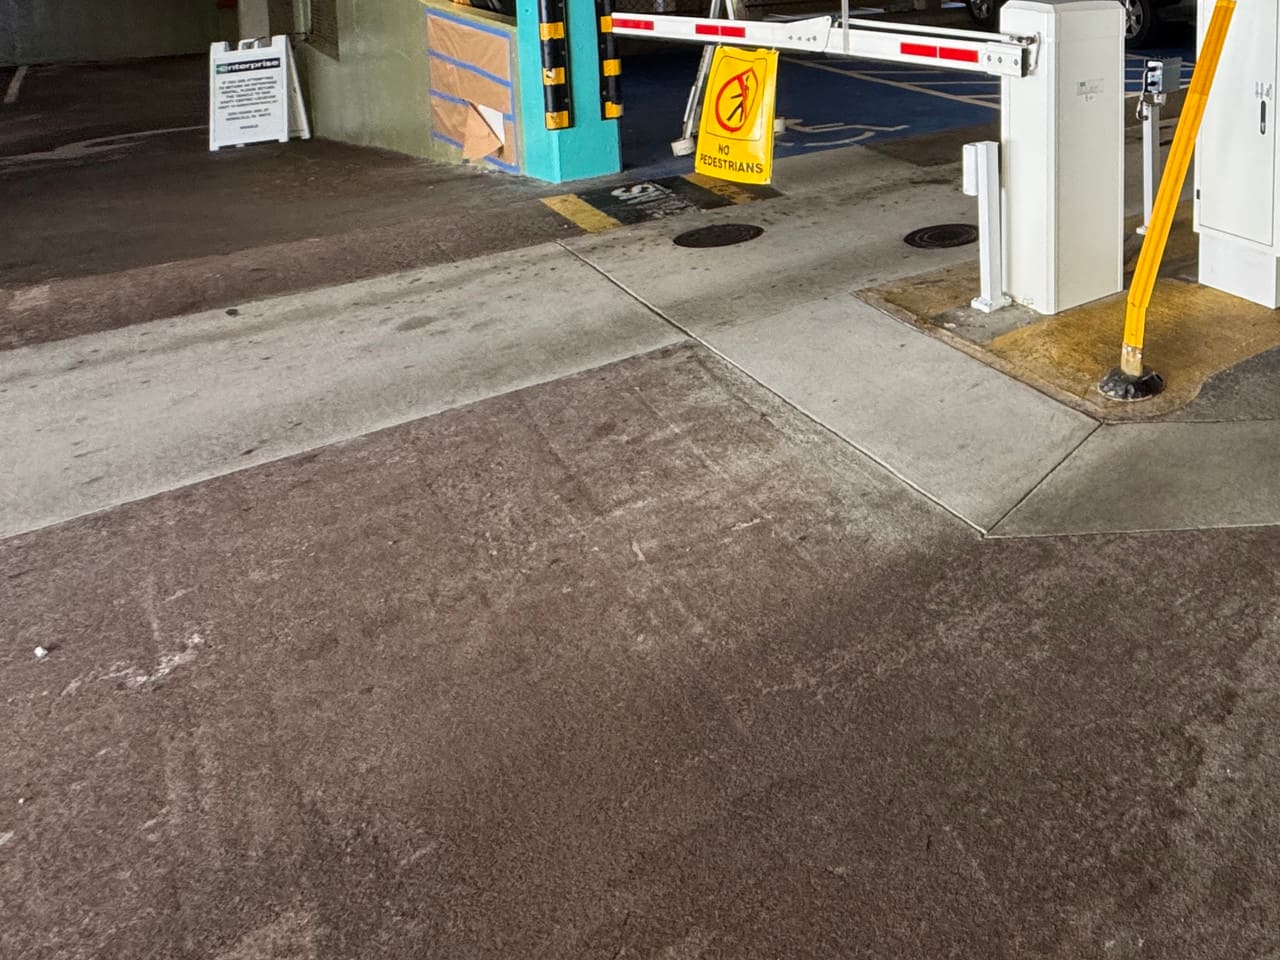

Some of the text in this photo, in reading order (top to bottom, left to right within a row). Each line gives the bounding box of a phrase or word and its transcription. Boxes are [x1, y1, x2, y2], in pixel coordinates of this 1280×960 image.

[218, 60, 279, 72] enterprise
[718, 143, 730, 156] NO
[699, 153, 764, 174] PEDESTRIANS
